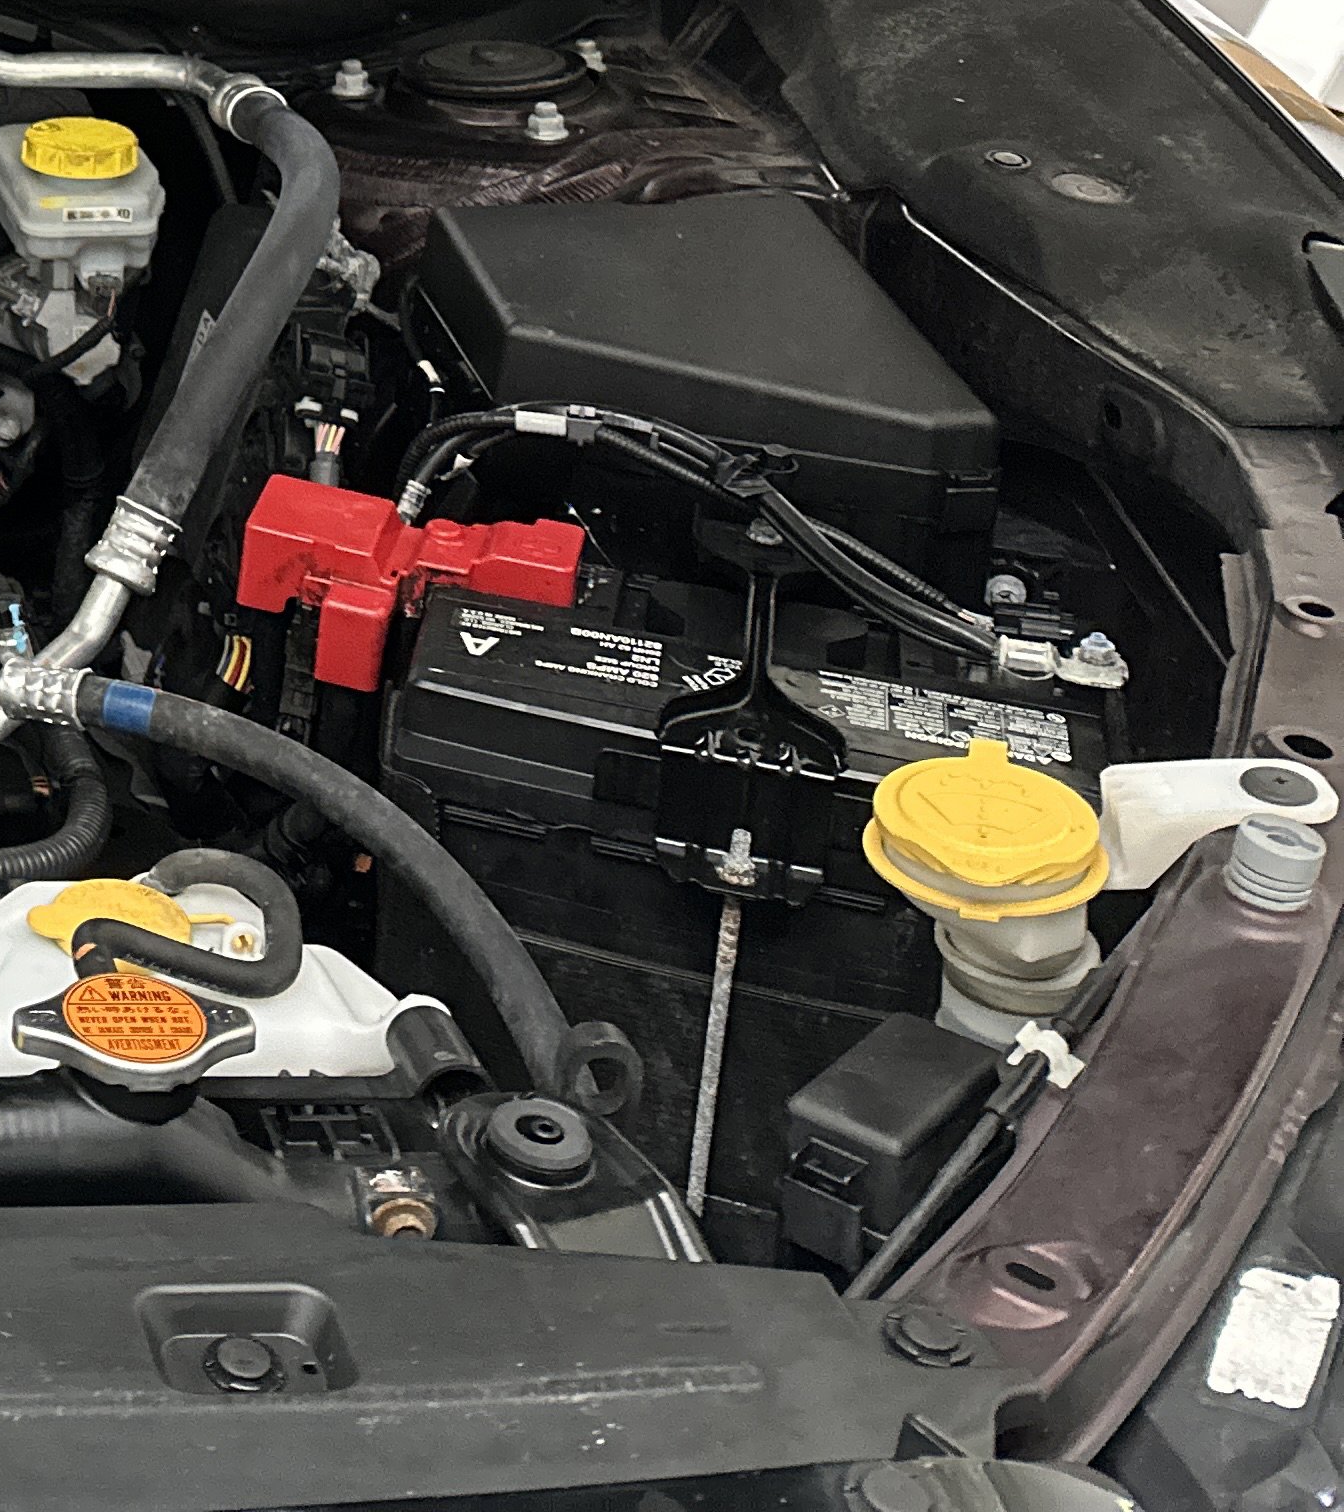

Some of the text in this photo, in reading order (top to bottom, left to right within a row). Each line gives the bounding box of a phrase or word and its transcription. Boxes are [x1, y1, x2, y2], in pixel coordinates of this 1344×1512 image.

[567, 665, 626, 681] CRANKING
[583, 661, 629, 675] AMPS
[625, 676, 658, 687] COLD
[108, 991, 171, 1001] WARNING
